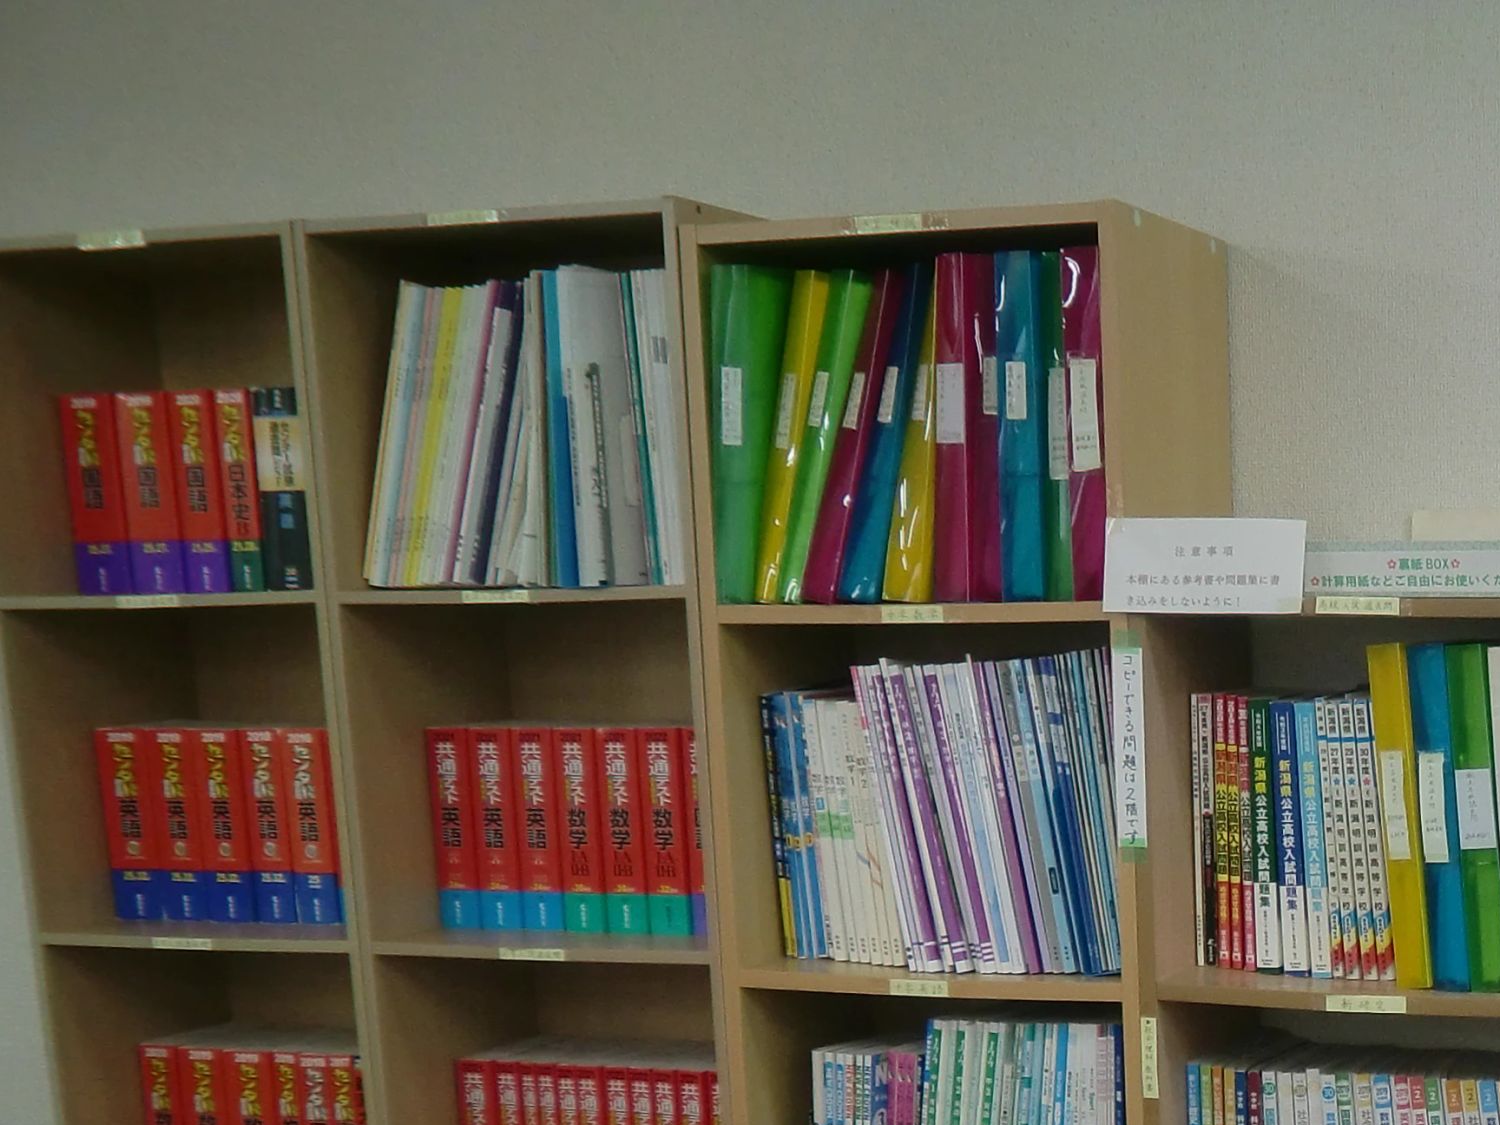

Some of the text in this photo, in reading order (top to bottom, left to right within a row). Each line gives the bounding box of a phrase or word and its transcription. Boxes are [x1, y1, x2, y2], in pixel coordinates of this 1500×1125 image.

[1398, 558, 1450, 570] 裏紙 BOX
[441, 806, 462, 848] 英語
[483, 807, 504, 849] 英語
[526, 807, 547, 849] 英語
[567, 808, 588, 850] 数学
[610, 808, 631, 850] 数学
[652, 808, 674, 850] 数学
[1254, 756, 1271, 908] 新潟県公立高校入試問題集
[1278, 759, 1298, 911] 新潟県公立高校入試問題集
